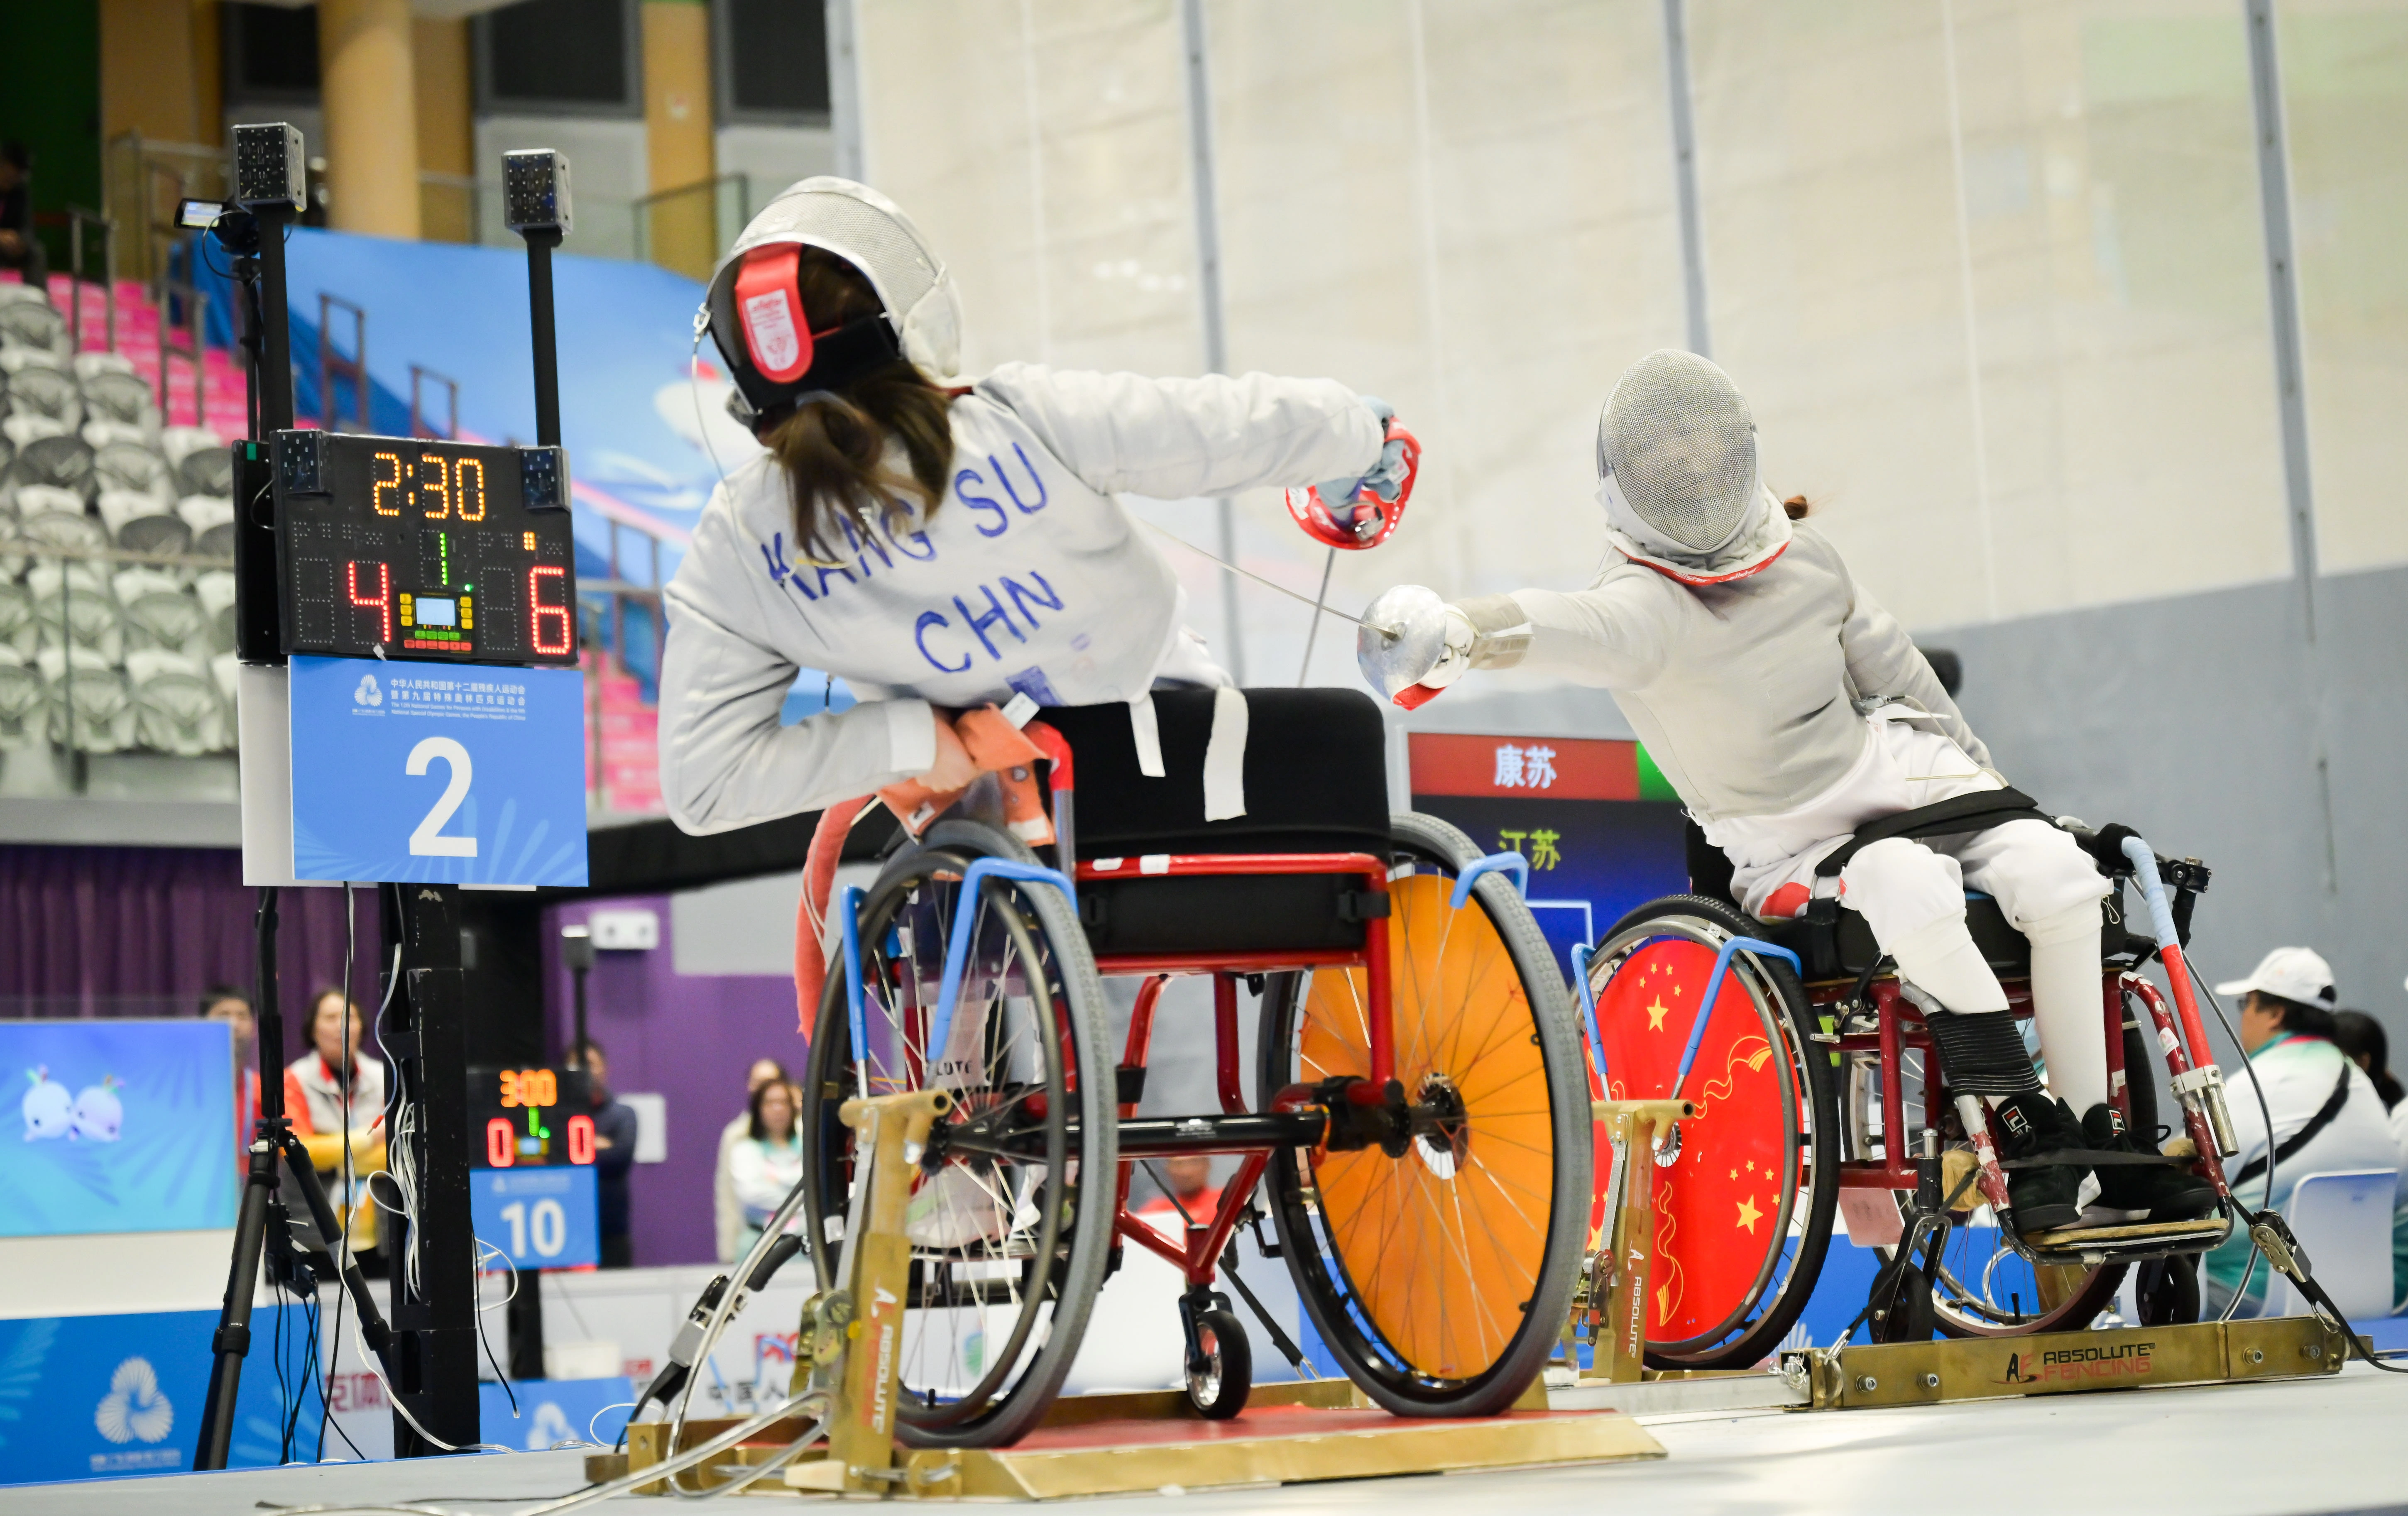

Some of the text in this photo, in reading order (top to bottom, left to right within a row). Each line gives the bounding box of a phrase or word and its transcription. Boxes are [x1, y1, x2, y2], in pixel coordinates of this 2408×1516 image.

[373, 452, 485, 522] 2:30
[954, 442, 1047, 538] SU
[348, 561, 392, 643] 4
[529, 566, 570, 655] 6
[915, 570, 1065, 674] CHN
[405, 736, 477, 858] 2
[1495, 744, 1557, 789] 康苏
[1498, 829, 1561, 870] 江苏
[499, 1069, 558, 1108] 3:00
[487, 1117, 515, 1168] 0
[568, 1114, 597, 1165] 0
[501, 1198, 566, 1259] 10
[2043, 1356, 2151, 1382] FENCING
